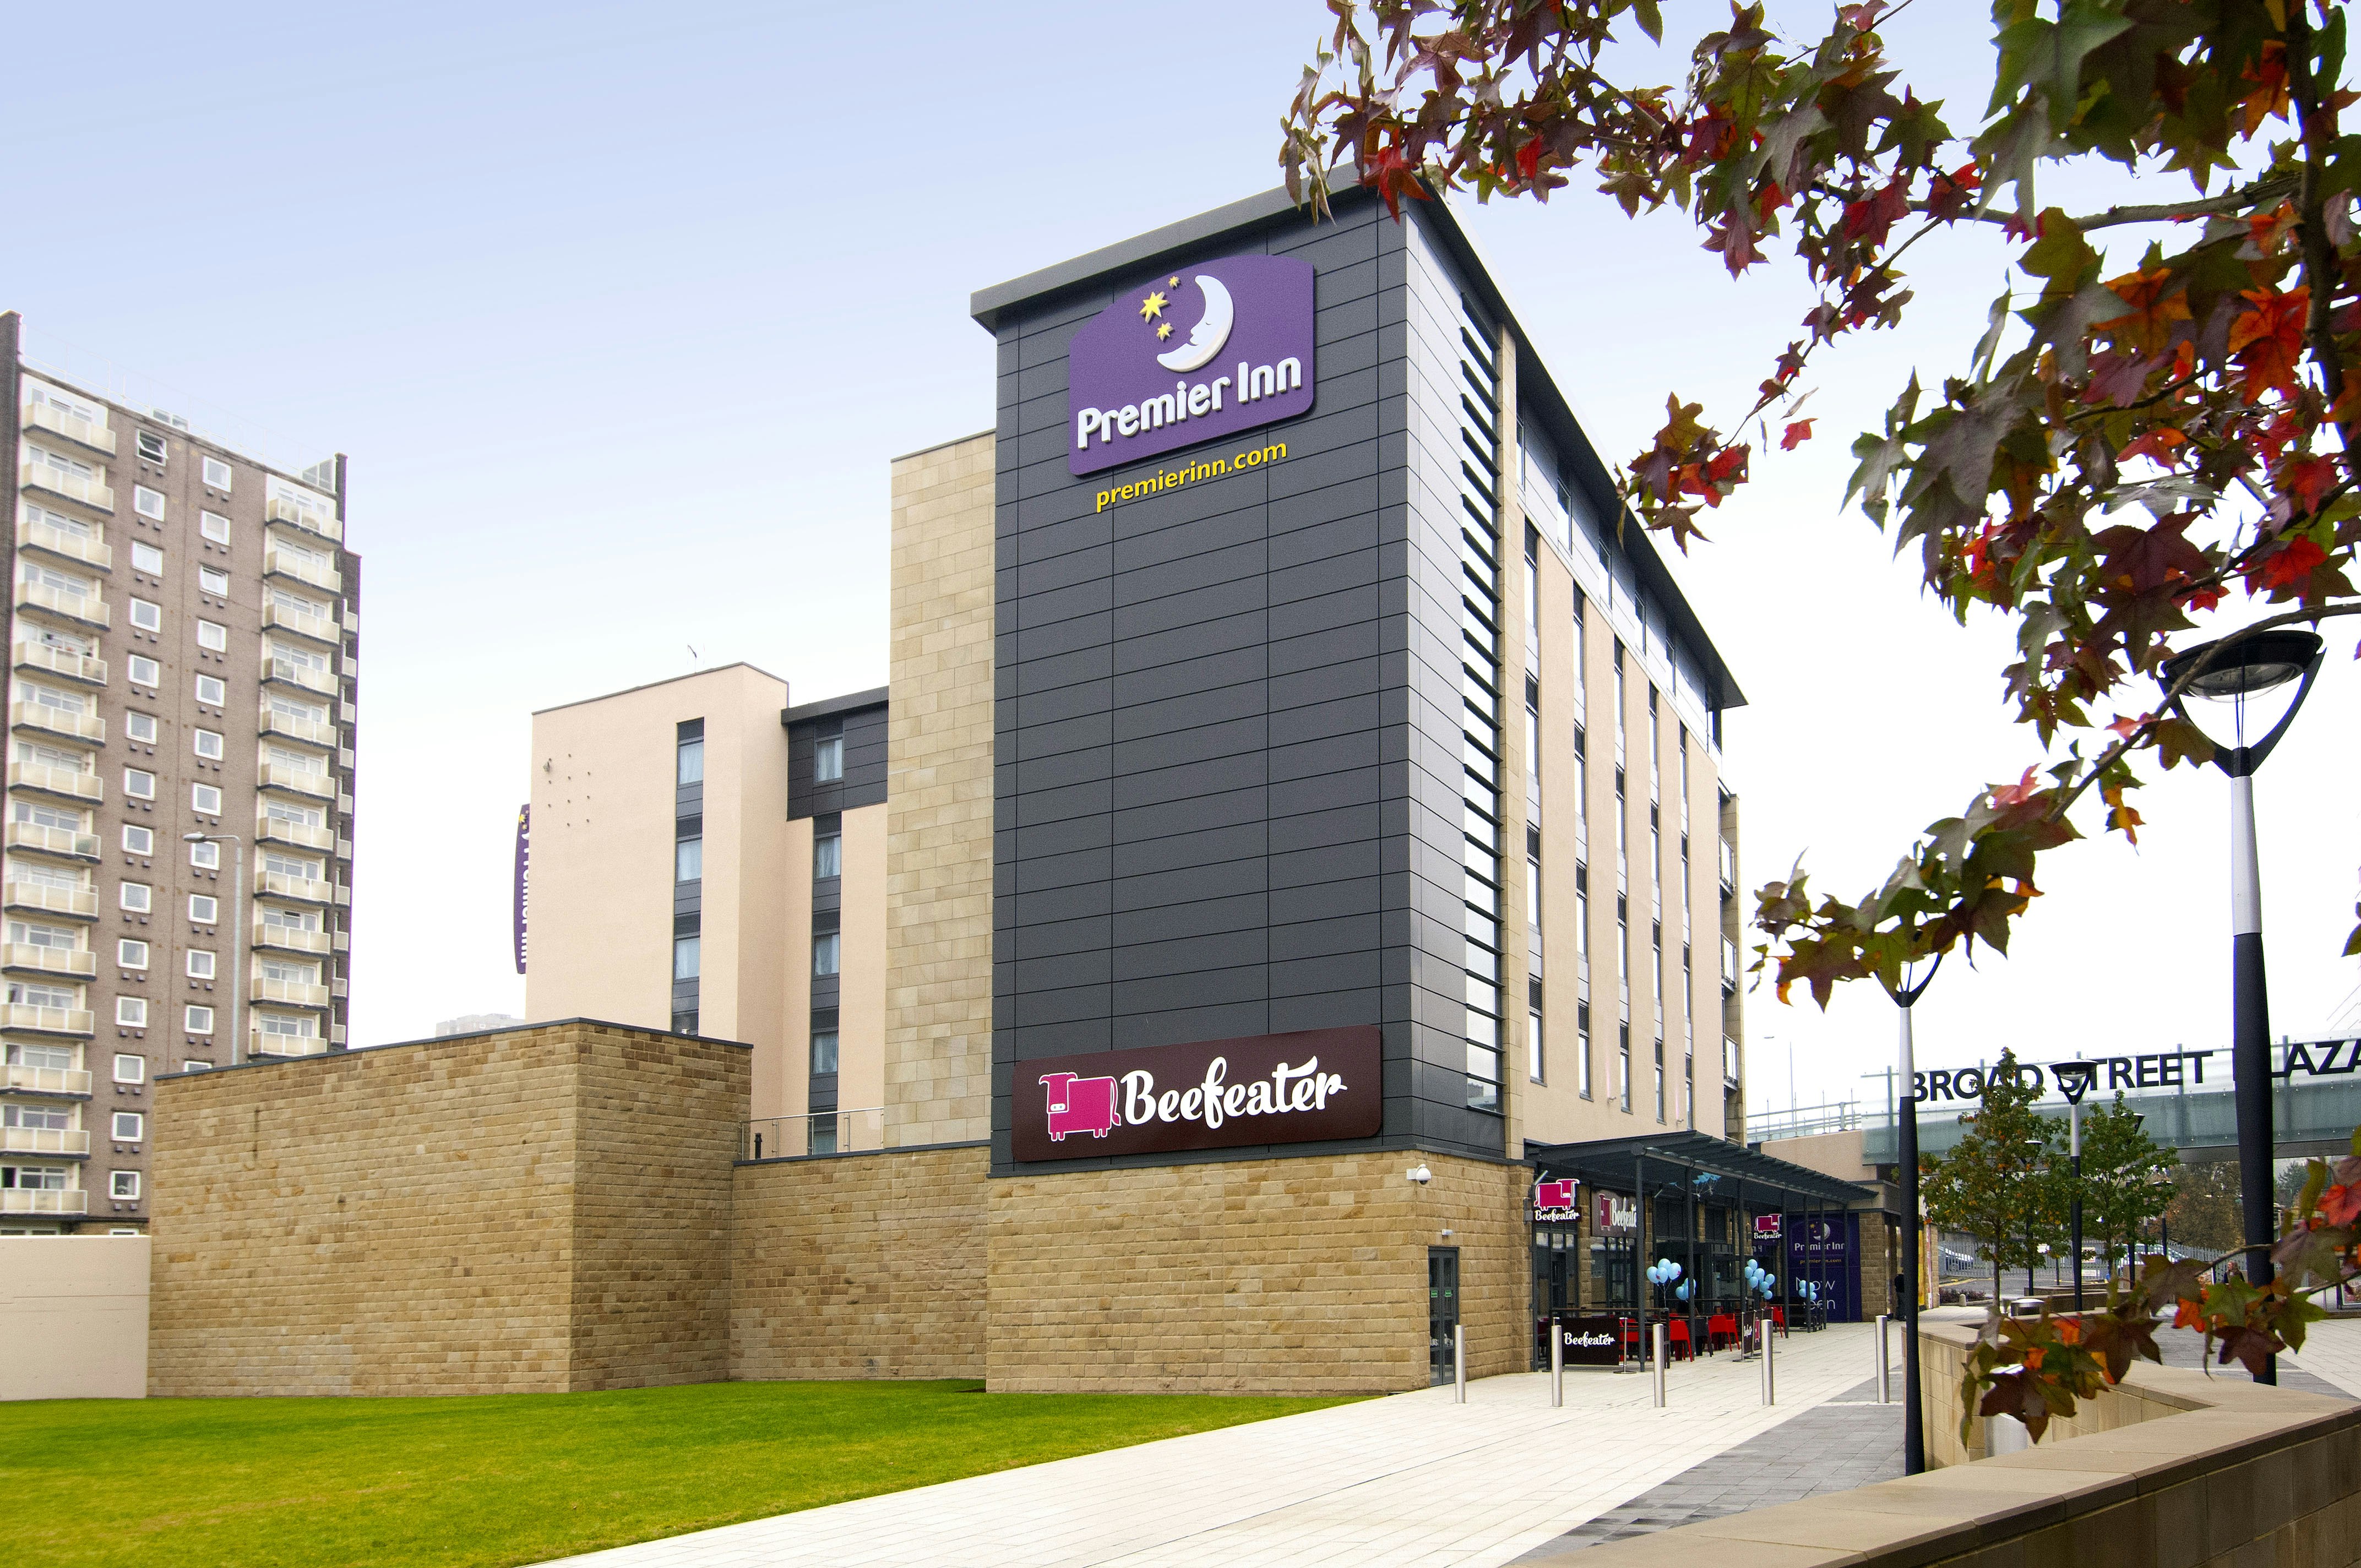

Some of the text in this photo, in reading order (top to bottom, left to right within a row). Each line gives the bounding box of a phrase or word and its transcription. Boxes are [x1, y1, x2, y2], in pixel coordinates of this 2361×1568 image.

[1078, 357, 1301, 450] Premier Inn
[1096, 442, 1288, 513] premierinn.com
[1120, 1055, 1347, 1129] Beefeater
[1535, 1208, 1580, 1222] Beefeater
[1794, 1242, 1830, 1251] Prmir
[1564, 1331, 1615, 1347] Beefeater
